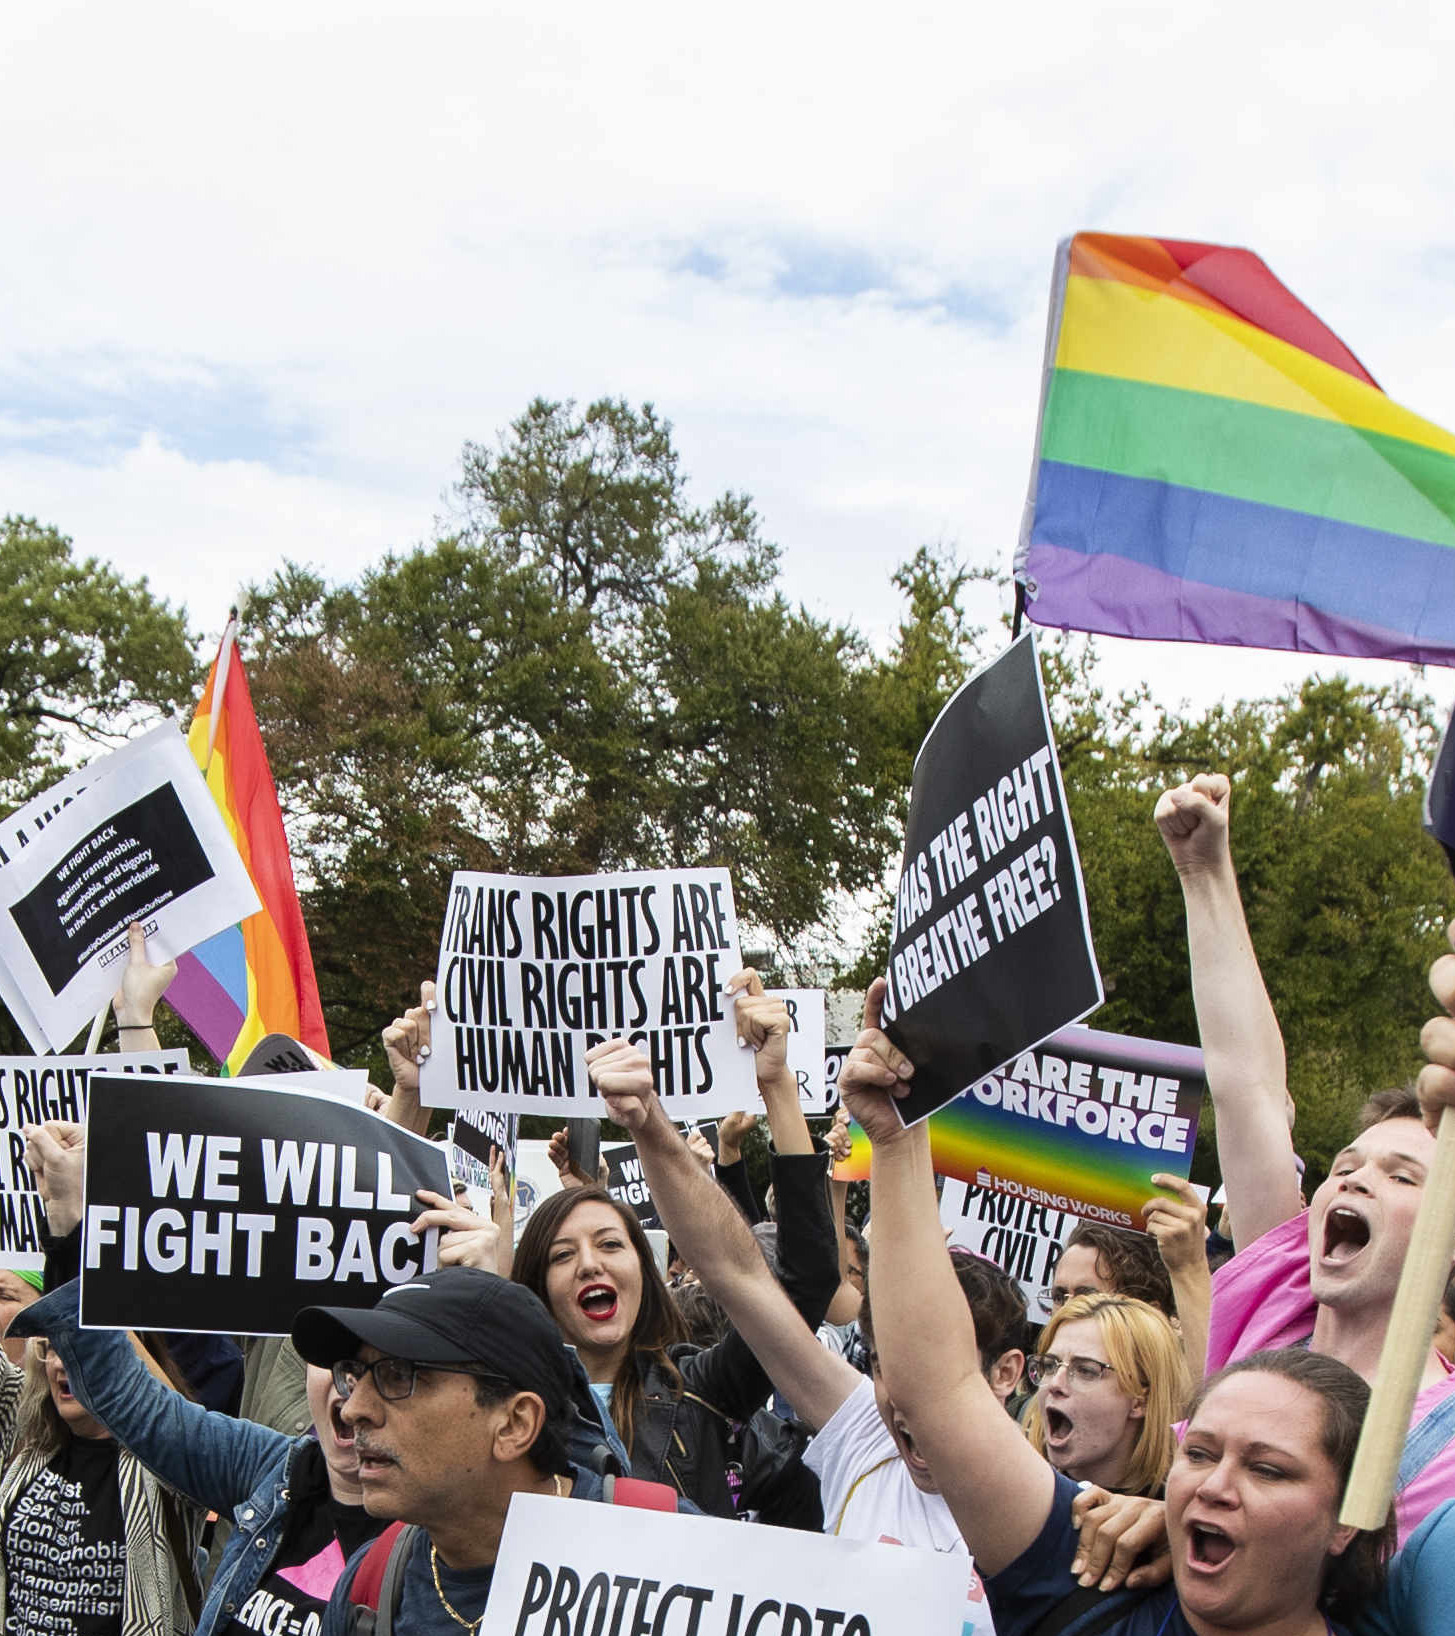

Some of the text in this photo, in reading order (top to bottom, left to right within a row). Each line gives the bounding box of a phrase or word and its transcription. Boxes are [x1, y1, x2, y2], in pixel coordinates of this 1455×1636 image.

[57, 838, 141, 908] against transphobia,
[69, 843, 92, 871] FIGHT
[90, 825, 118, 850] BACK
[103, 866, 122, 885] and
[119, 848, 153, 873] bigotry
[899, 744, 1054, 934] HAS THE RIGHT
[74, 915, 87, 932] the
[98, 888, 117, 908] and
[114, 862, 161, 896] worldwide
[446, 882, 730, 960] TRANS RIGHTS ARE
[893, 892, 992, 1012] BREATHE
[983, 835, 1062, 944] FREE?
[99, 939, 130, 968] HEALT
[445, 956, 513, 1027] CIVIL
[520, 959, 647, 1030] RIGHTS
[660, 953, 724, 1026] ARE
[454, 1025, 714, 1098] HUMAN RHTS
[1011, 1051, 1180, 1115] ARE THE
[13, 1066, 108, 1129] RIGHT
[968, 1072, 1191, 1153] ORKFORCE
[147, 1131, 242, 1202] WE
[261, 1138, 411, 1212] WILL
[994, 1175, 1132, 1226] HOUSING WORKS
[86, 1205, 276, 1278] FIGHT
[961, 1183, 1065, 1240] PROTECT
[980, 1226, 1039, 1284] CIVIL
